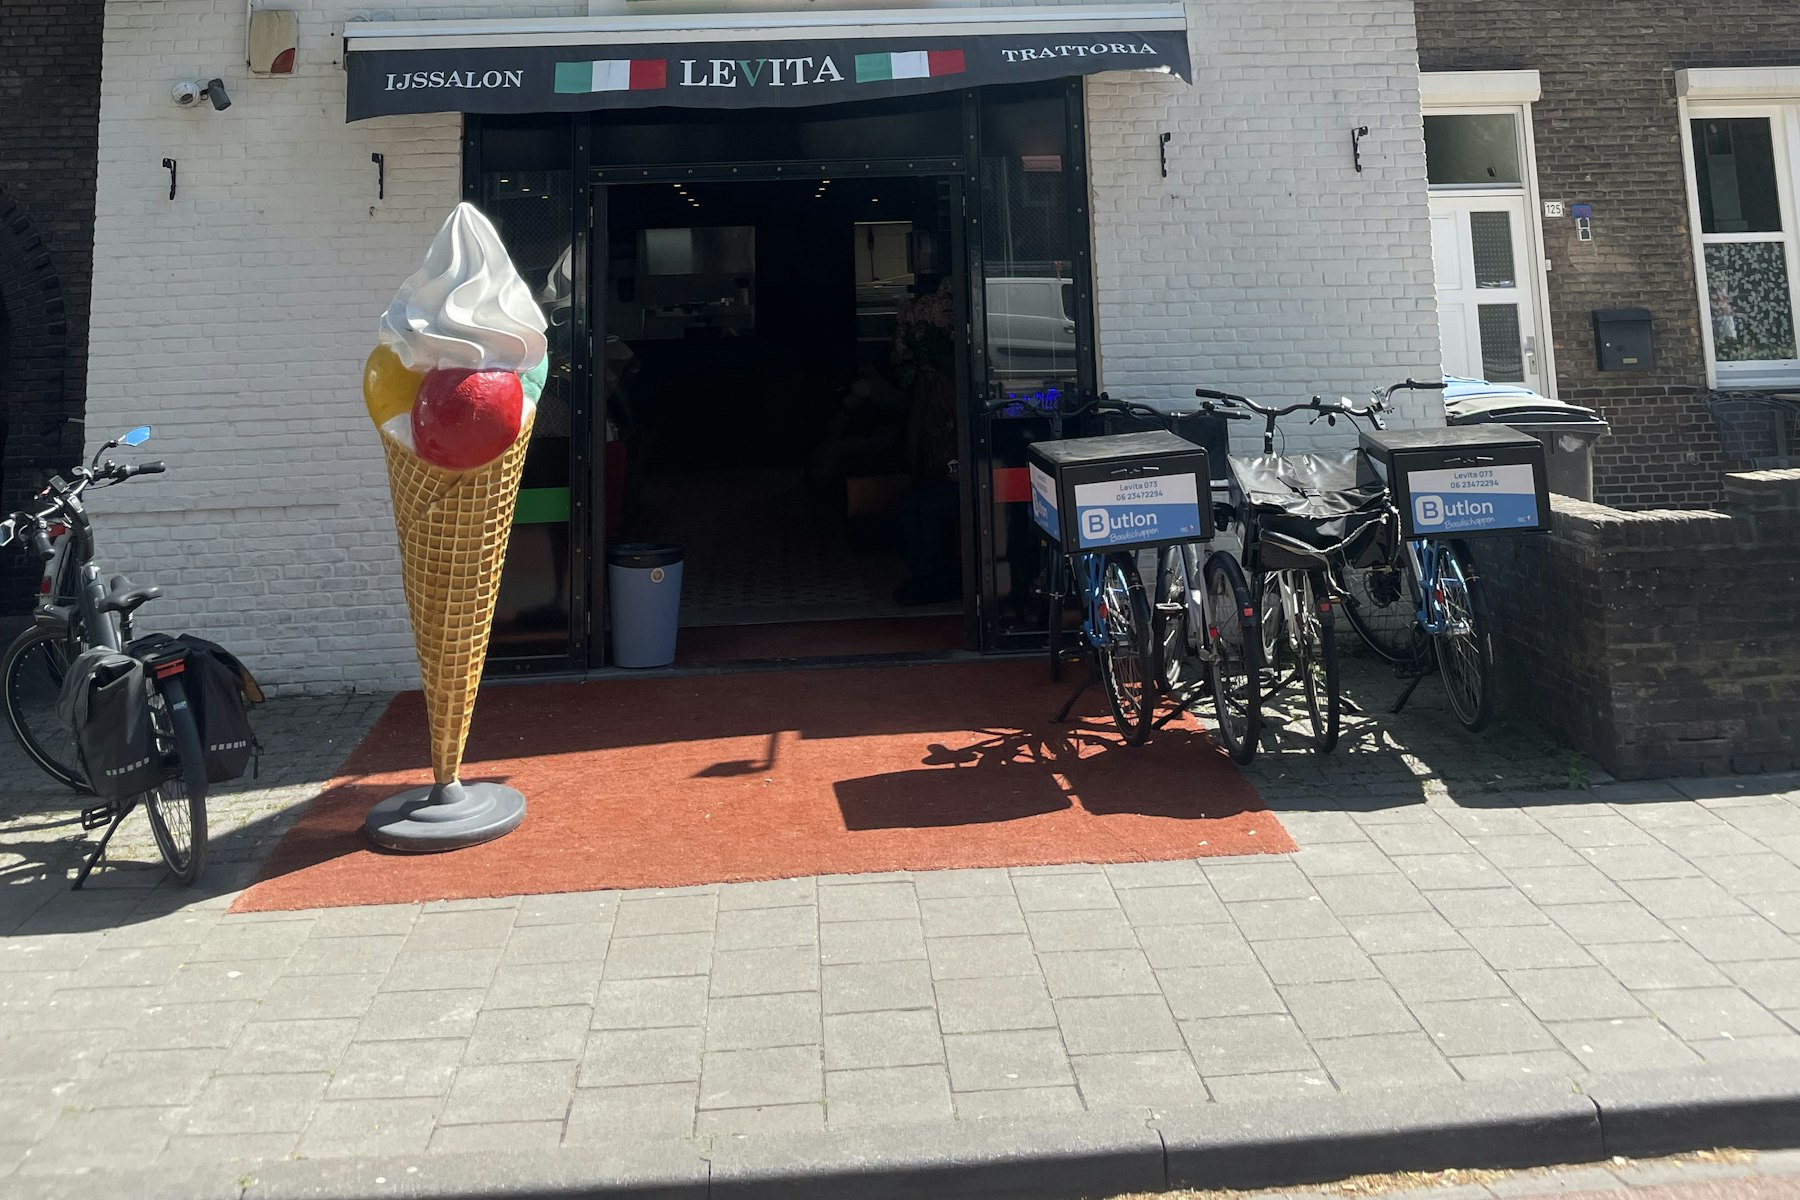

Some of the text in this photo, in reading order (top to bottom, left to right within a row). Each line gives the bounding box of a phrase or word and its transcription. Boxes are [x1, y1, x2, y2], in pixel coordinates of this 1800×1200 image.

[385, 43, 1157, 91] IJSSALON LEVITA TRATTORIA
[1546, 204, 1562, 215] 125
[1453, 470, 1494, 480] Levita 073
[1119, 481, 1158, 492] Levita 073
[1420, 498, 1494, 521] Butlon
[1085, 510, 1158, 535] Butlon
